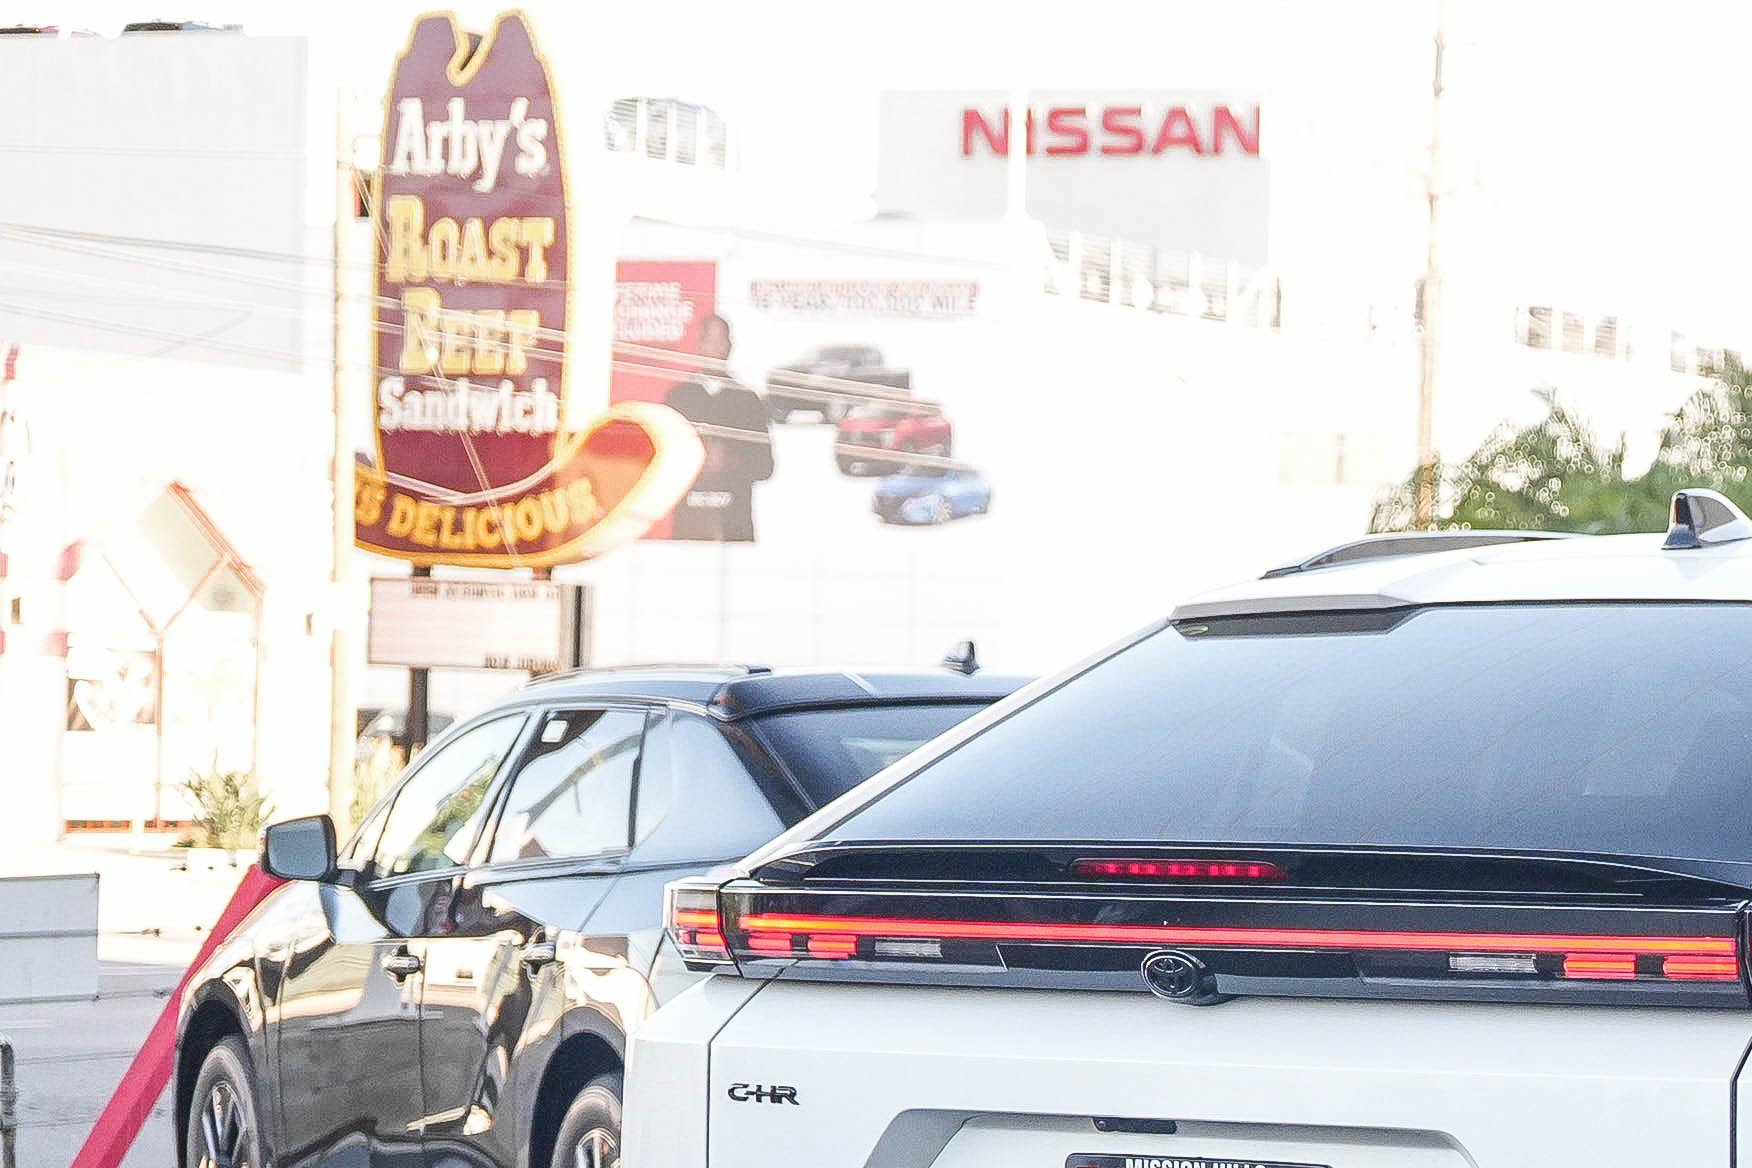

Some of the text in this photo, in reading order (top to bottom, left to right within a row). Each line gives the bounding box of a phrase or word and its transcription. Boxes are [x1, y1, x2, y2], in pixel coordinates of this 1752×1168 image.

[390, 96, 548, 193] Arby's
[961, 104, 1261, 158] NISSAN
[378, 374, 561, 435] Sandwich
[385, 477, 601, 551] DELICIOUS
[727, 1082, 800, 1106] C-HR
